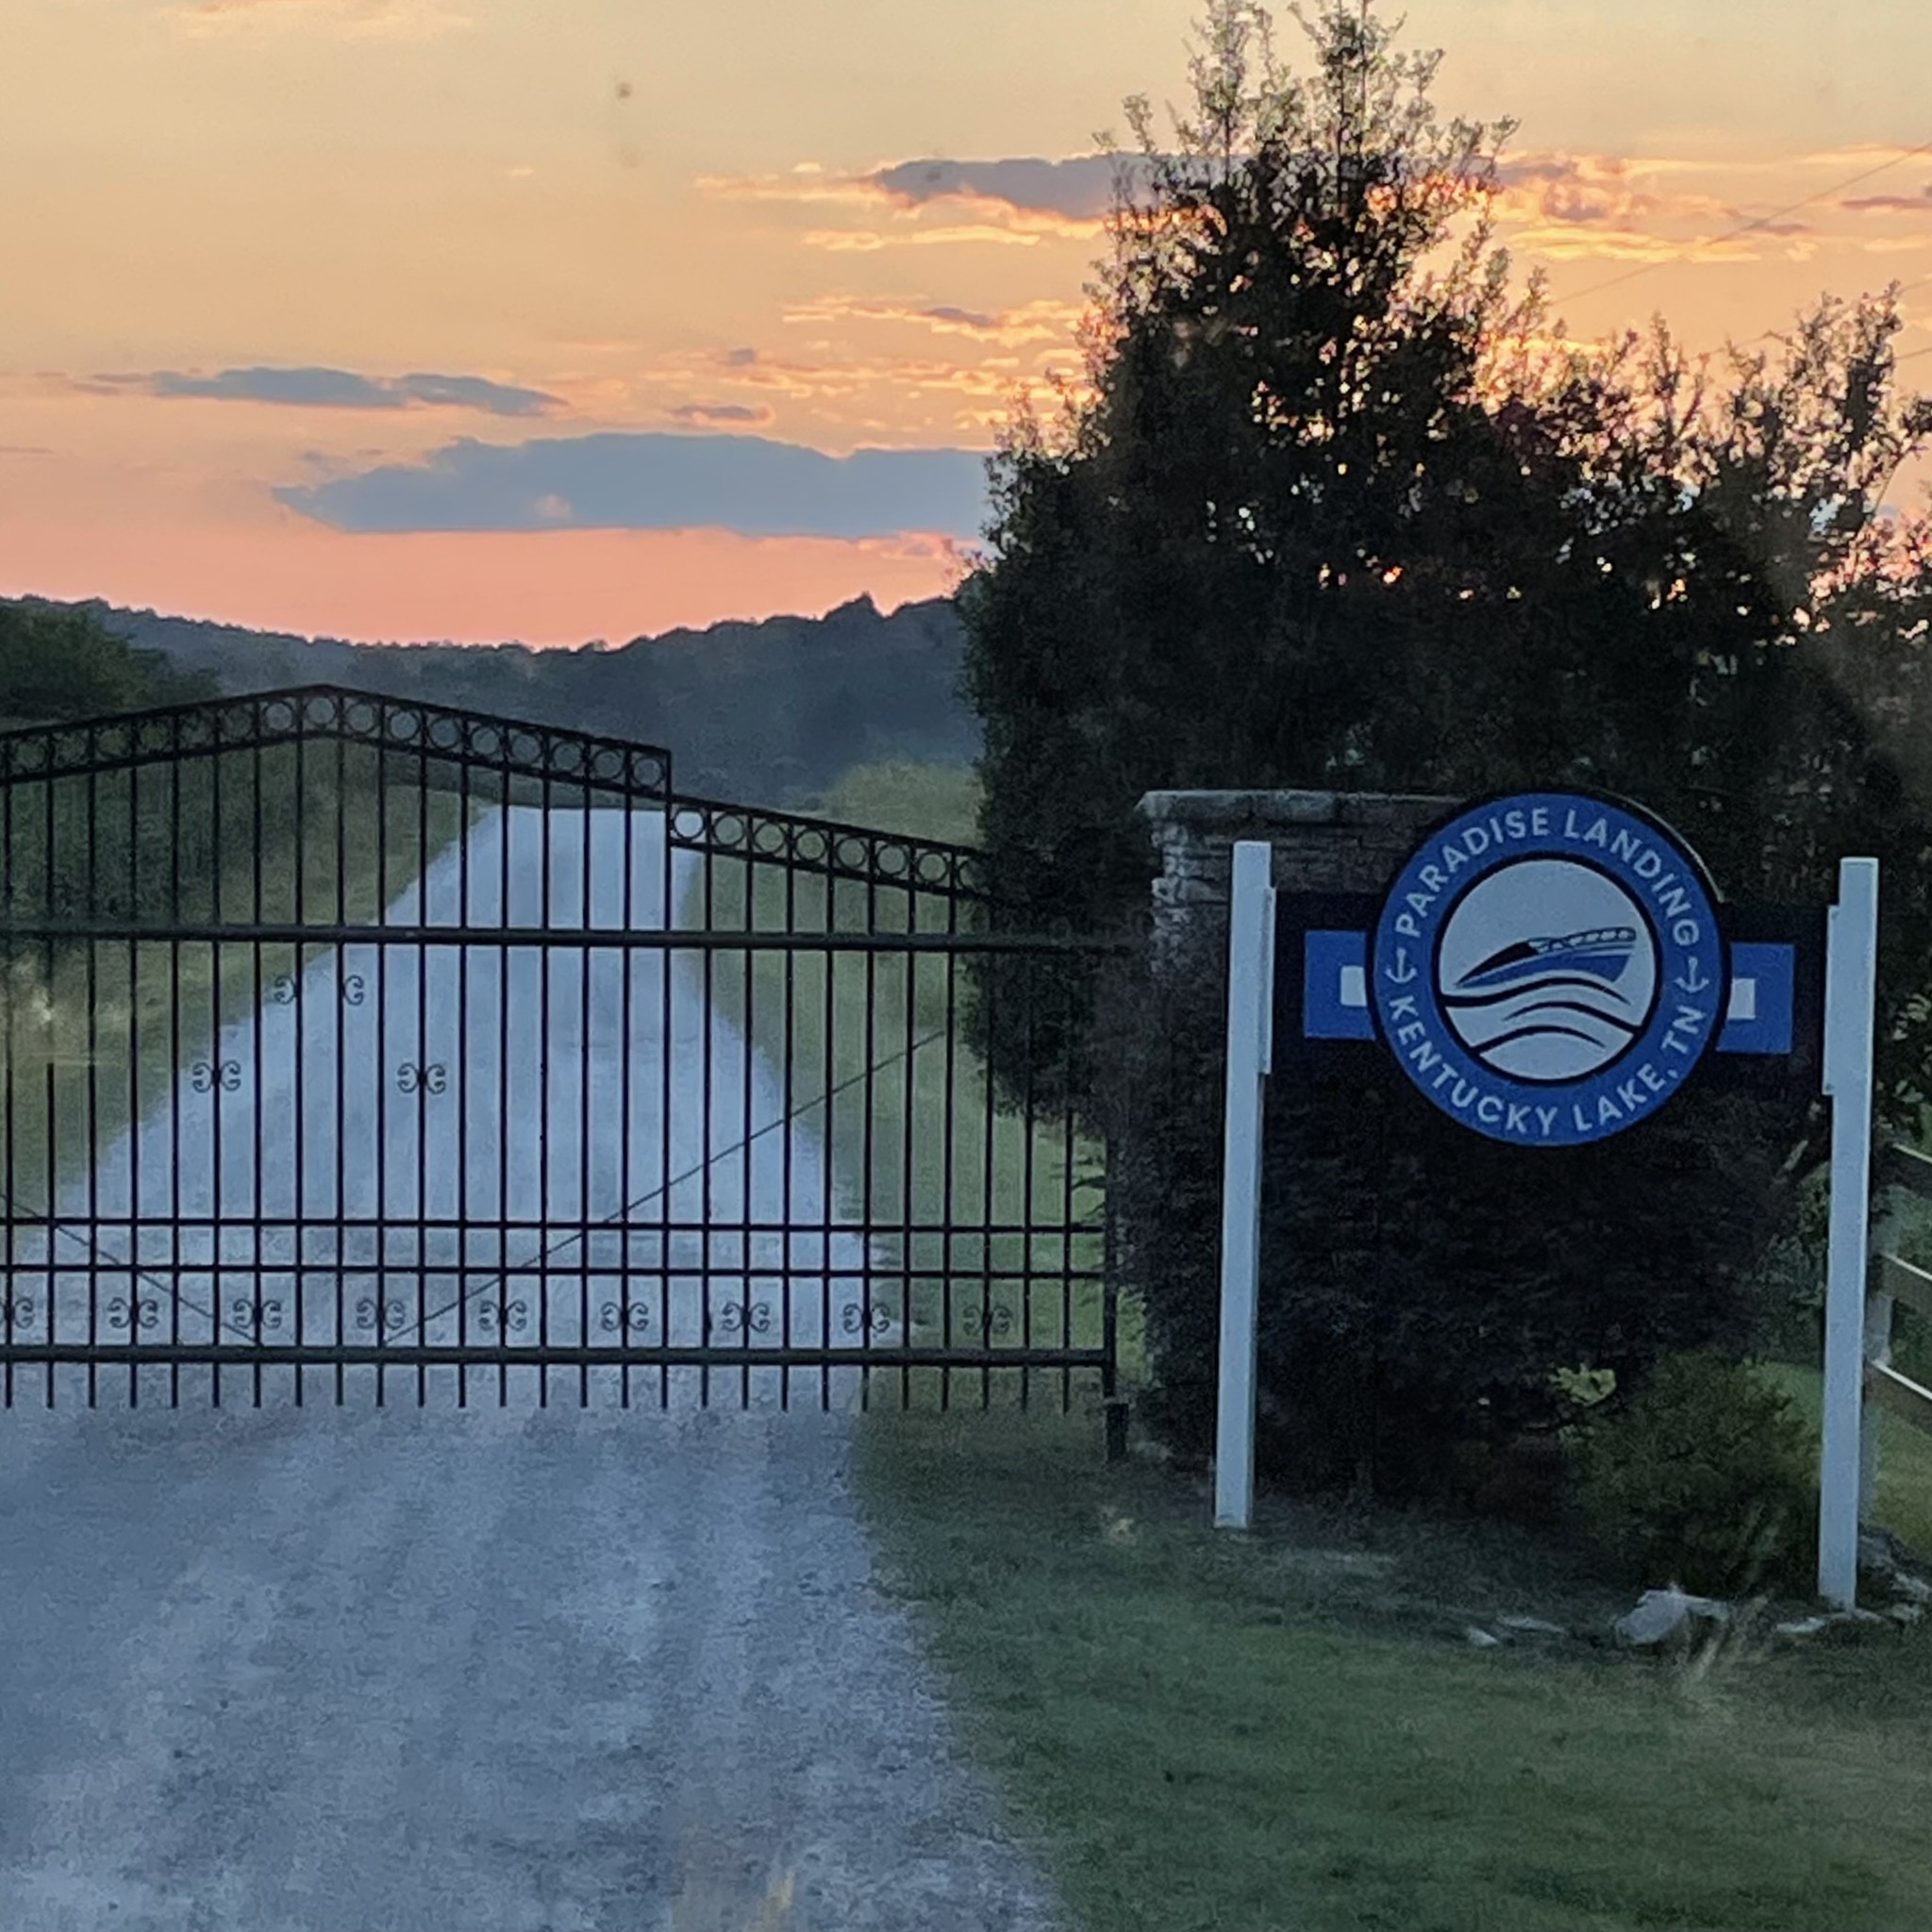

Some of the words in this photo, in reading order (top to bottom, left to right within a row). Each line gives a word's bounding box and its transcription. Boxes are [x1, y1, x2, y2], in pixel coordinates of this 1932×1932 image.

[1395, 807, 1549, 938] PARADISE
[1563, 809, 1700, 946] LANDING
[1389, 995, 1558, 1136] KENTUCKY
[1573, 1063, 1679, 1132] LAKE,
[1660, 1006, 1707, 1056] TN
